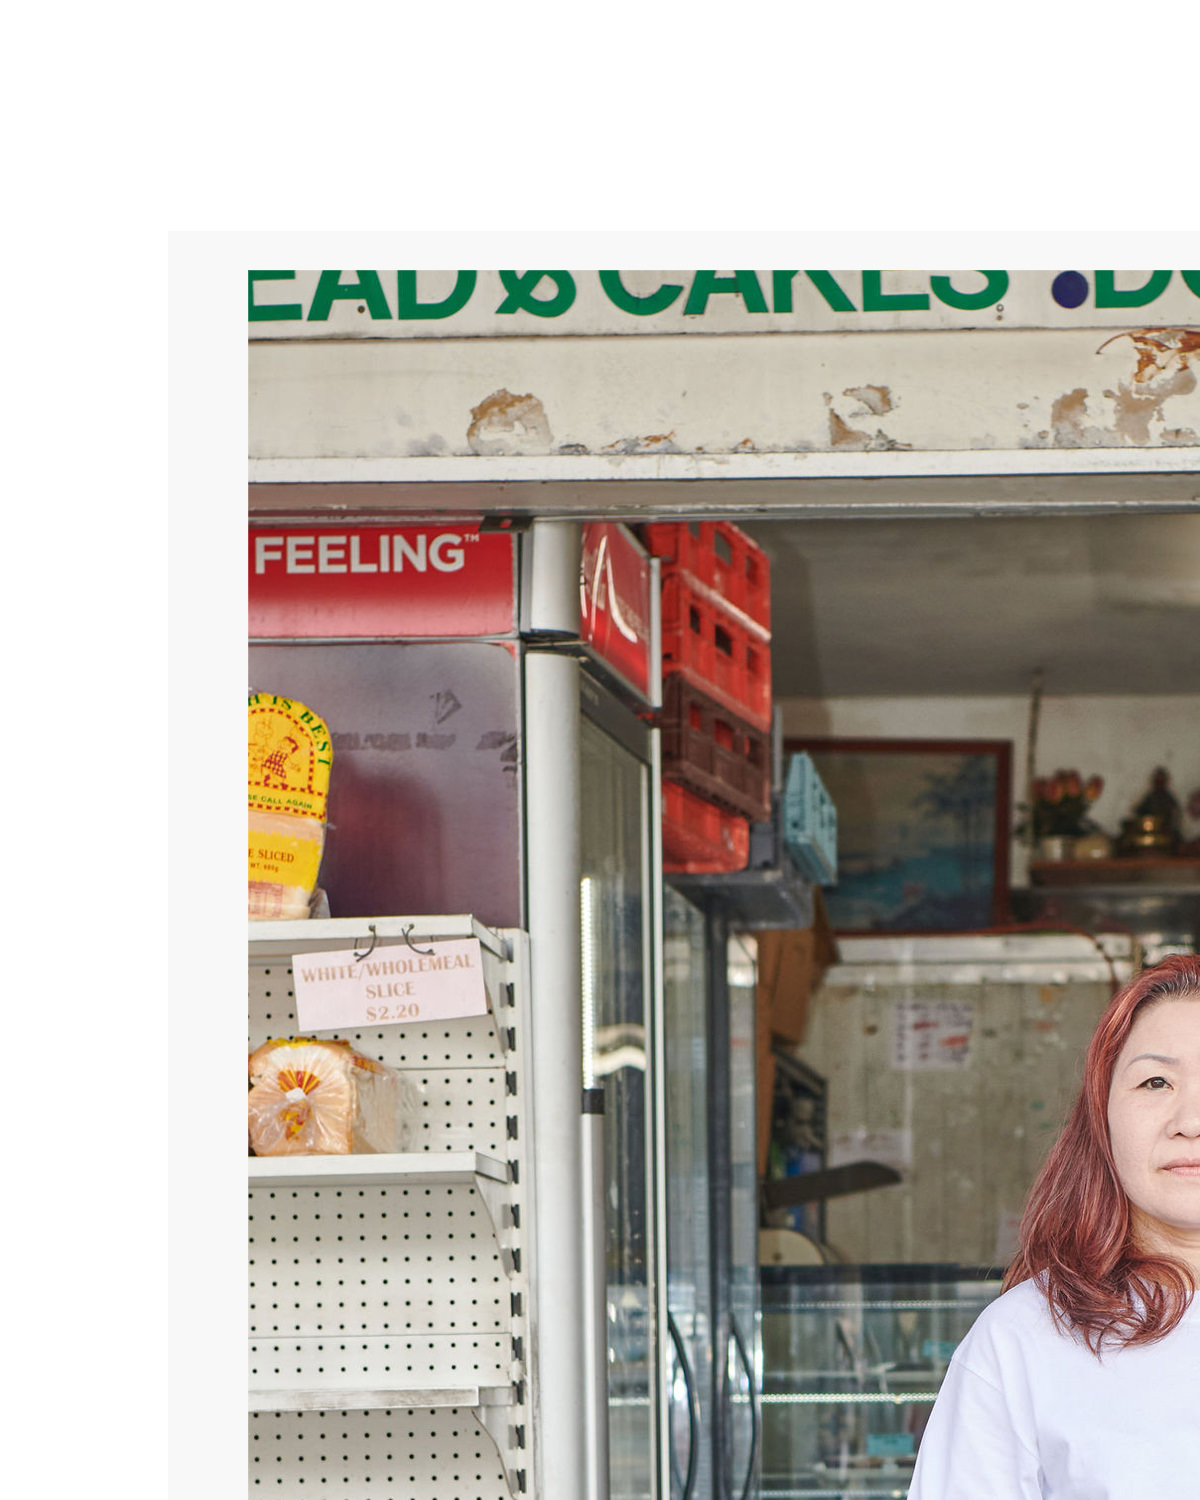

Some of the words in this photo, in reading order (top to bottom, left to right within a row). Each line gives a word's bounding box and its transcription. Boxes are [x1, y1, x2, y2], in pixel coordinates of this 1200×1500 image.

[300, 711, 332, 772] BEST
[261, 795, 282, 804] CALL
[286, 798, 313, 810] AGAIN
[258, 848, 295, 863] SLICED
[301, 953, 475, 983] WHITE/WHOLEMEAL
[365, 981, 416, 1000] SLICE
[366, 1002, 420, 1022] $2.20
